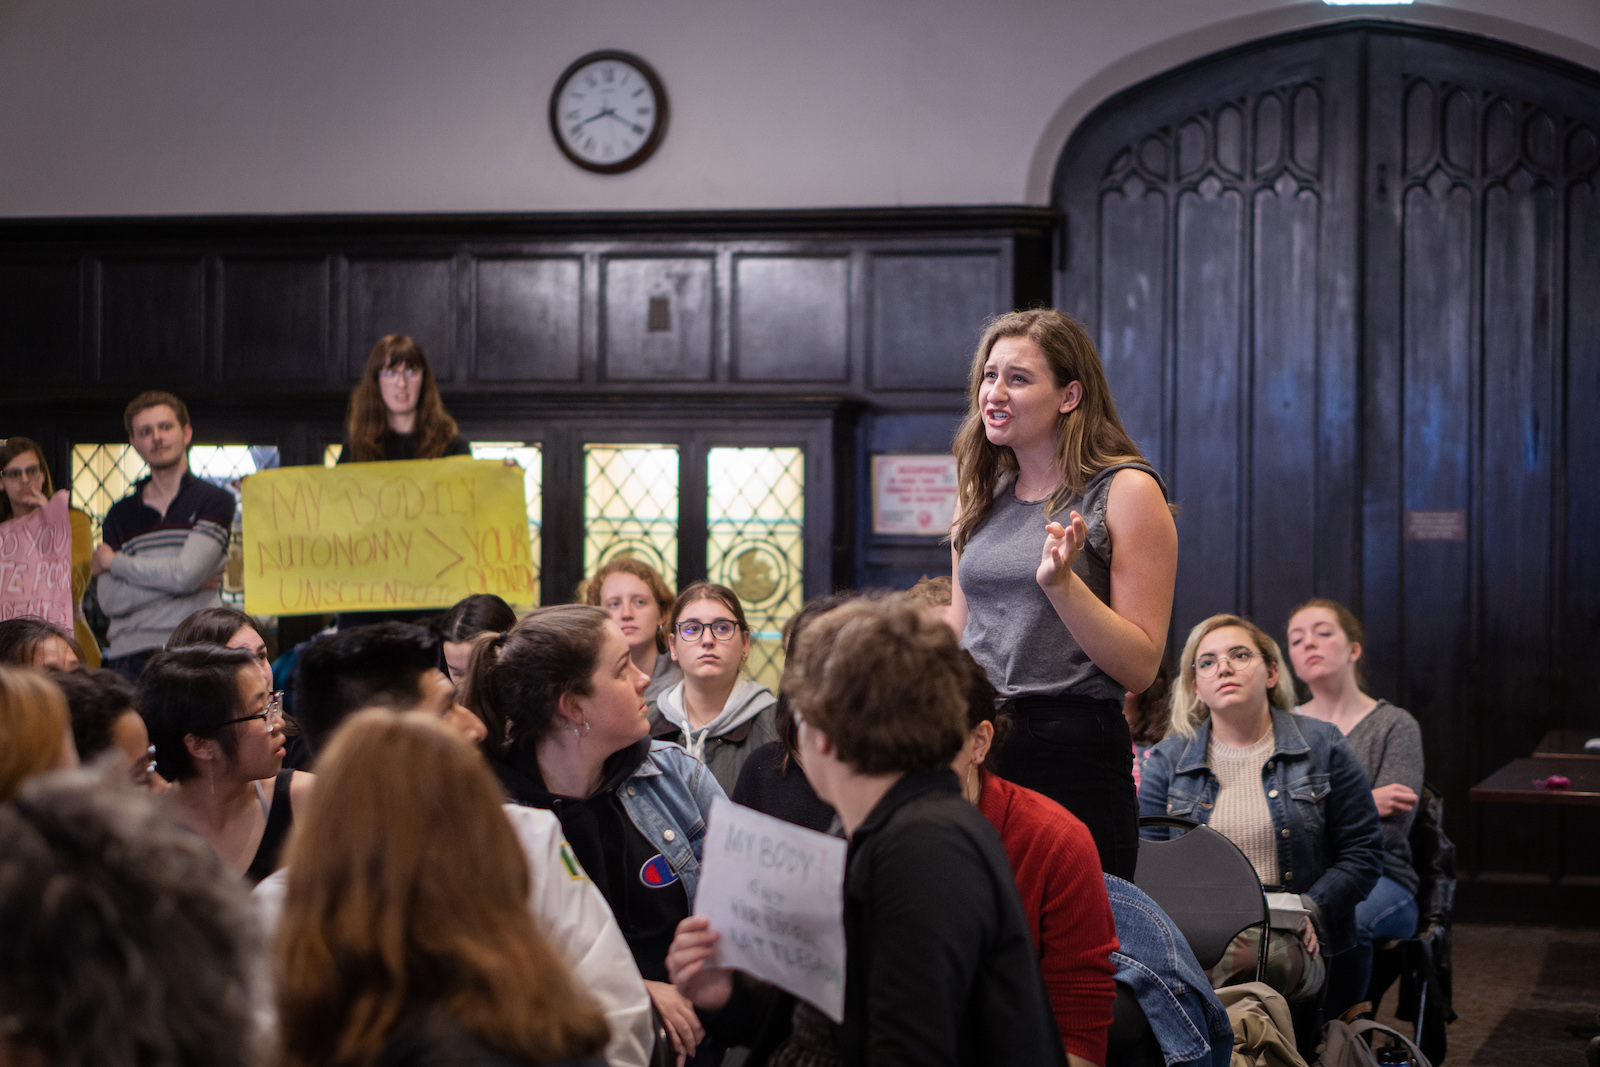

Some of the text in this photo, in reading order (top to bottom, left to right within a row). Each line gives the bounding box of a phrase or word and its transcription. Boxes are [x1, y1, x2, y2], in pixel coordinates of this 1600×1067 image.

[270, 474, 477, 531] MY BODILY
[22, 521, 68, 559] YOU
[257, 526, 414, 577] AUTONOMY
[460, 523, 530, 567] YOUR
[725, 822, 816, 883] MY BODY
